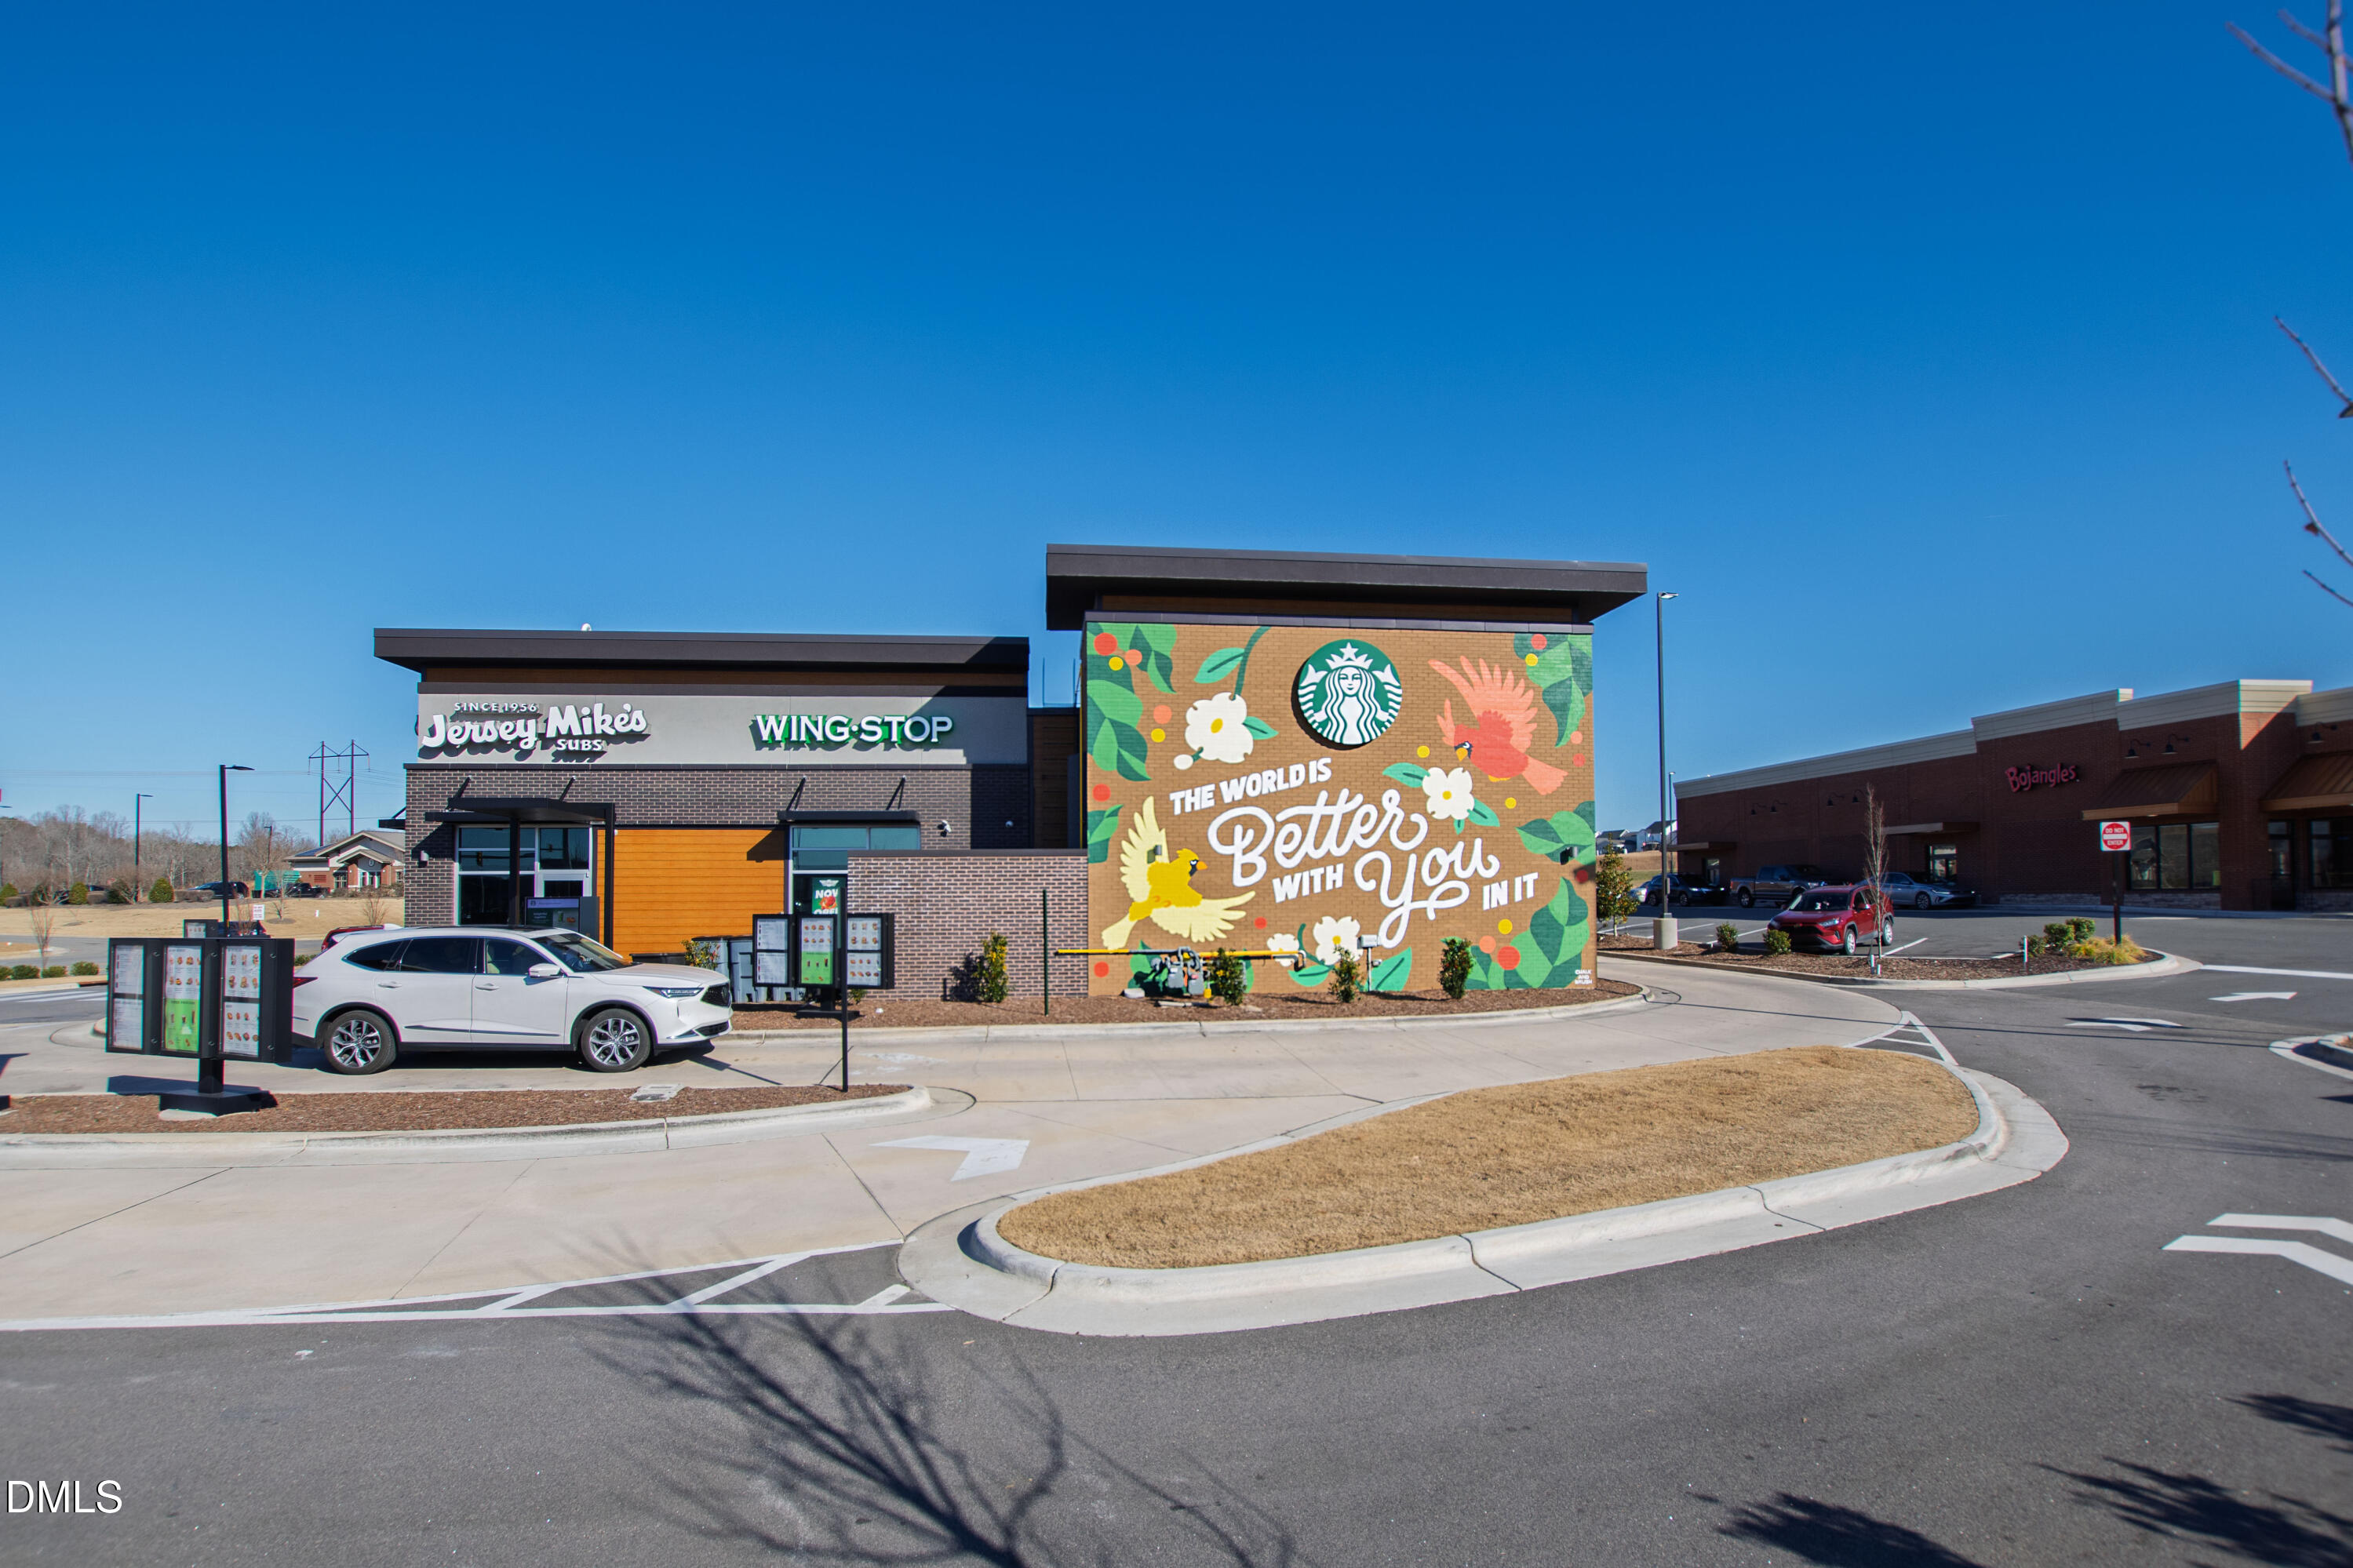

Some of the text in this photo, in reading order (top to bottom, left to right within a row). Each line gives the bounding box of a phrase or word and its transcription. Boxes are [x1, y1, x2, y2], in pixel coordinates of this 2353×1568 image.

[421, 702, 648, 750] Jersey Mike's
[454, 702, 538, 713] SINCE 1956
[555, 739, 603, 751] SUBS
[1169, 756, 1333, 816] THE WORLD IS
[2005, 763, 2077, 792] Bojangles
[1207, 788, 1429, 887] Better
[1272, 837, 1540, 950] WITH You IN IT
